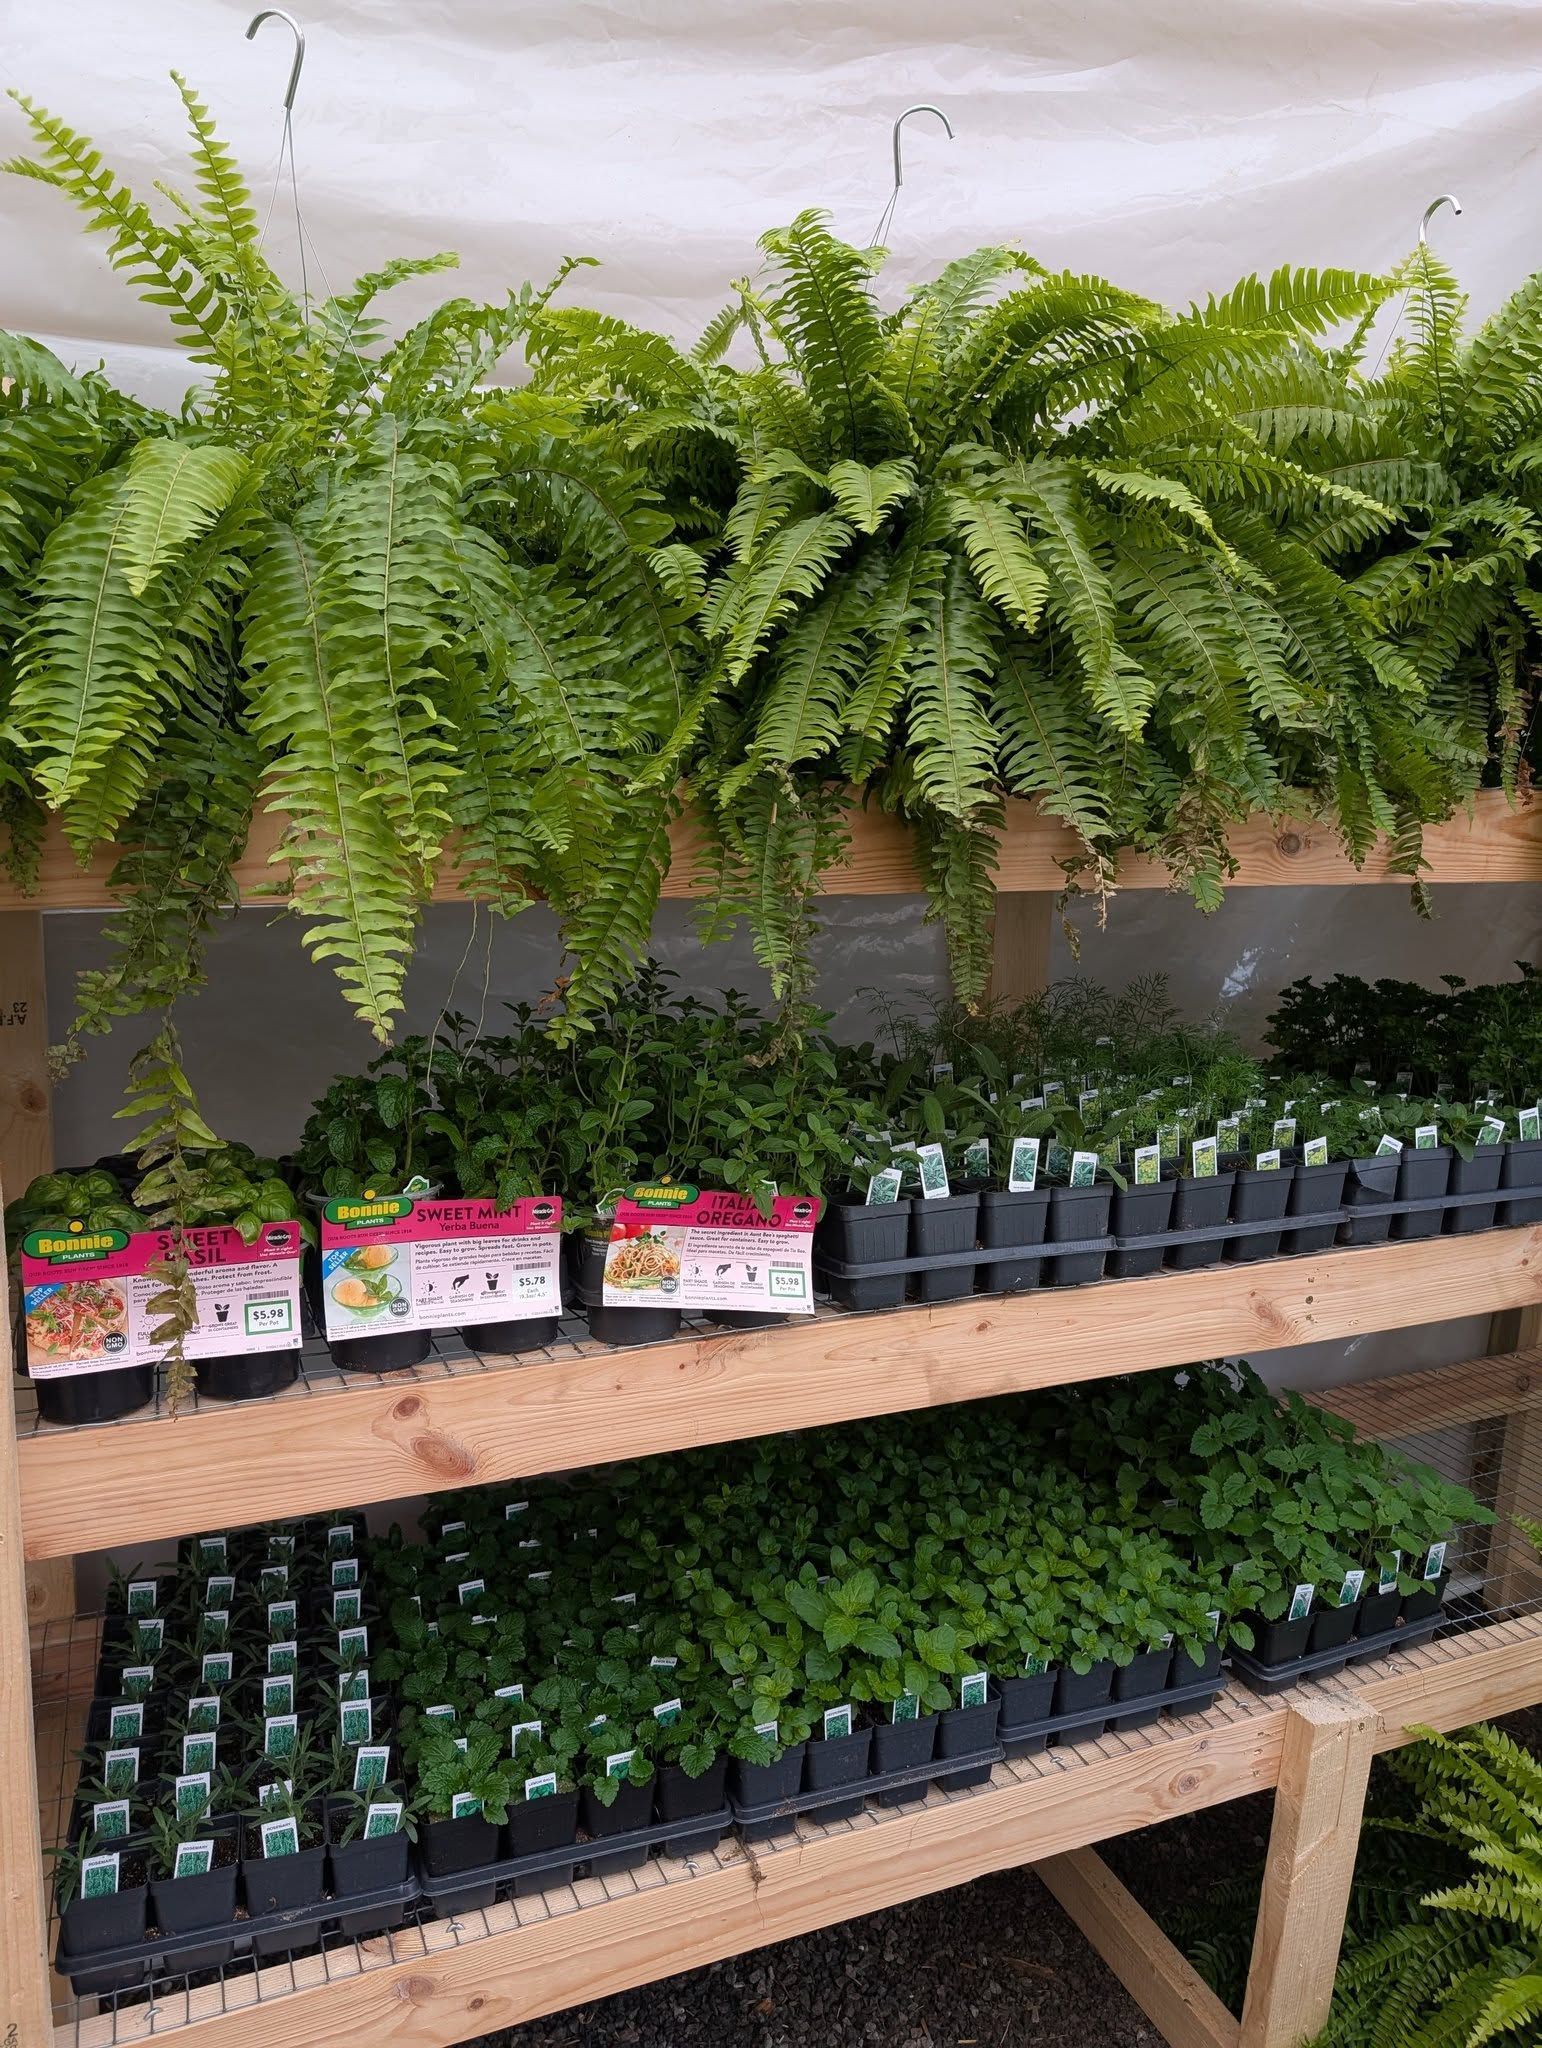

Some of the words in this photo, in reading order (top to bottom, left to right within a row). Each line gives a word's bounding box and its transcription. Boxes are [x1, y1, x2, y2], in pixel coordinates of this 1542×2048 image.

[634, 1187, 688, 1200] Bonnie
[338, 1201, 400, 1220] Bonnie
[417, 1207, 473, 1221] SWEET
[697, 1210, 782, 1228] OREGANO
[440, 1222, 467, 1232] Yerba
[470, 1222, 499, 1230] Buena
[39, 1235, 114, 1254] Bonnie
[62, 1252, 95, 1260] PLANTS
[328, 1251, 340, 1262] TOP
[328, 1252, 349, 1270] SELLER
[519, 1276, 546, 1287] $5.78
[775, 1277, 799, 1286] $5.98
[30, 1287, 44, 1298] TOP
[31, 1288, 53, 1306] SELLER
[253, 1309, 284, 1320] $5.98
[267, 1822, 291, 1831] ROSEMARY
[7, 2023, 18, 2037] 2
